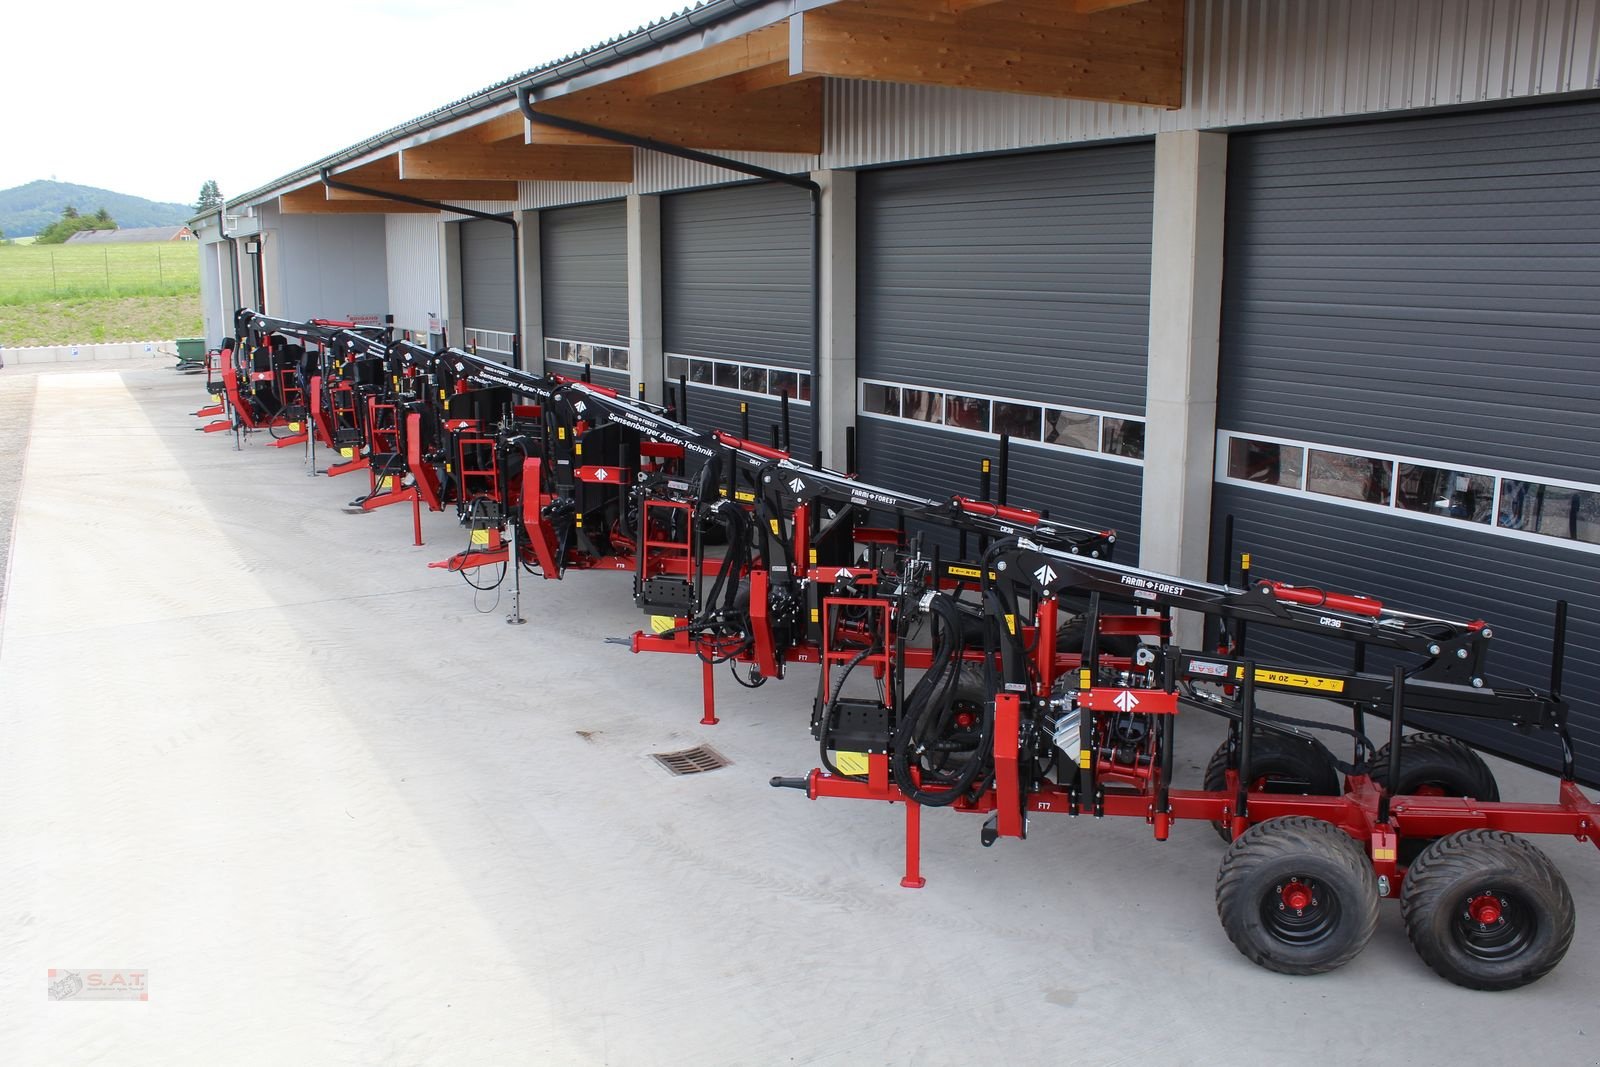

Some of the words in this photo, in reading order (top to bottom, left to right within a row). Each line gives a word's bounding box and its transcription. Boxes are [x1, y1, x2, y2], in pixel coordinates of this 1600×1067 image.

[479, 371, 519, 388] Sensenberger
[518, 383, 551, 398] Agrar-Tech
[641, 419, 658, 429] FOREST
[608, 413, 660, 437] Sensenberger
[660, 432, 714, 457] Agrar-Technik
[851, 488, 869, 498] FARMI
[874, 494, 897, 505] FOREST
[1121, 575, 1146, 588] FARMI
[1154, 582, 1185, 596] FOREST
[1320, 616, 1342, 628] CR36
[1038, 802, 1051, 810] FT7
